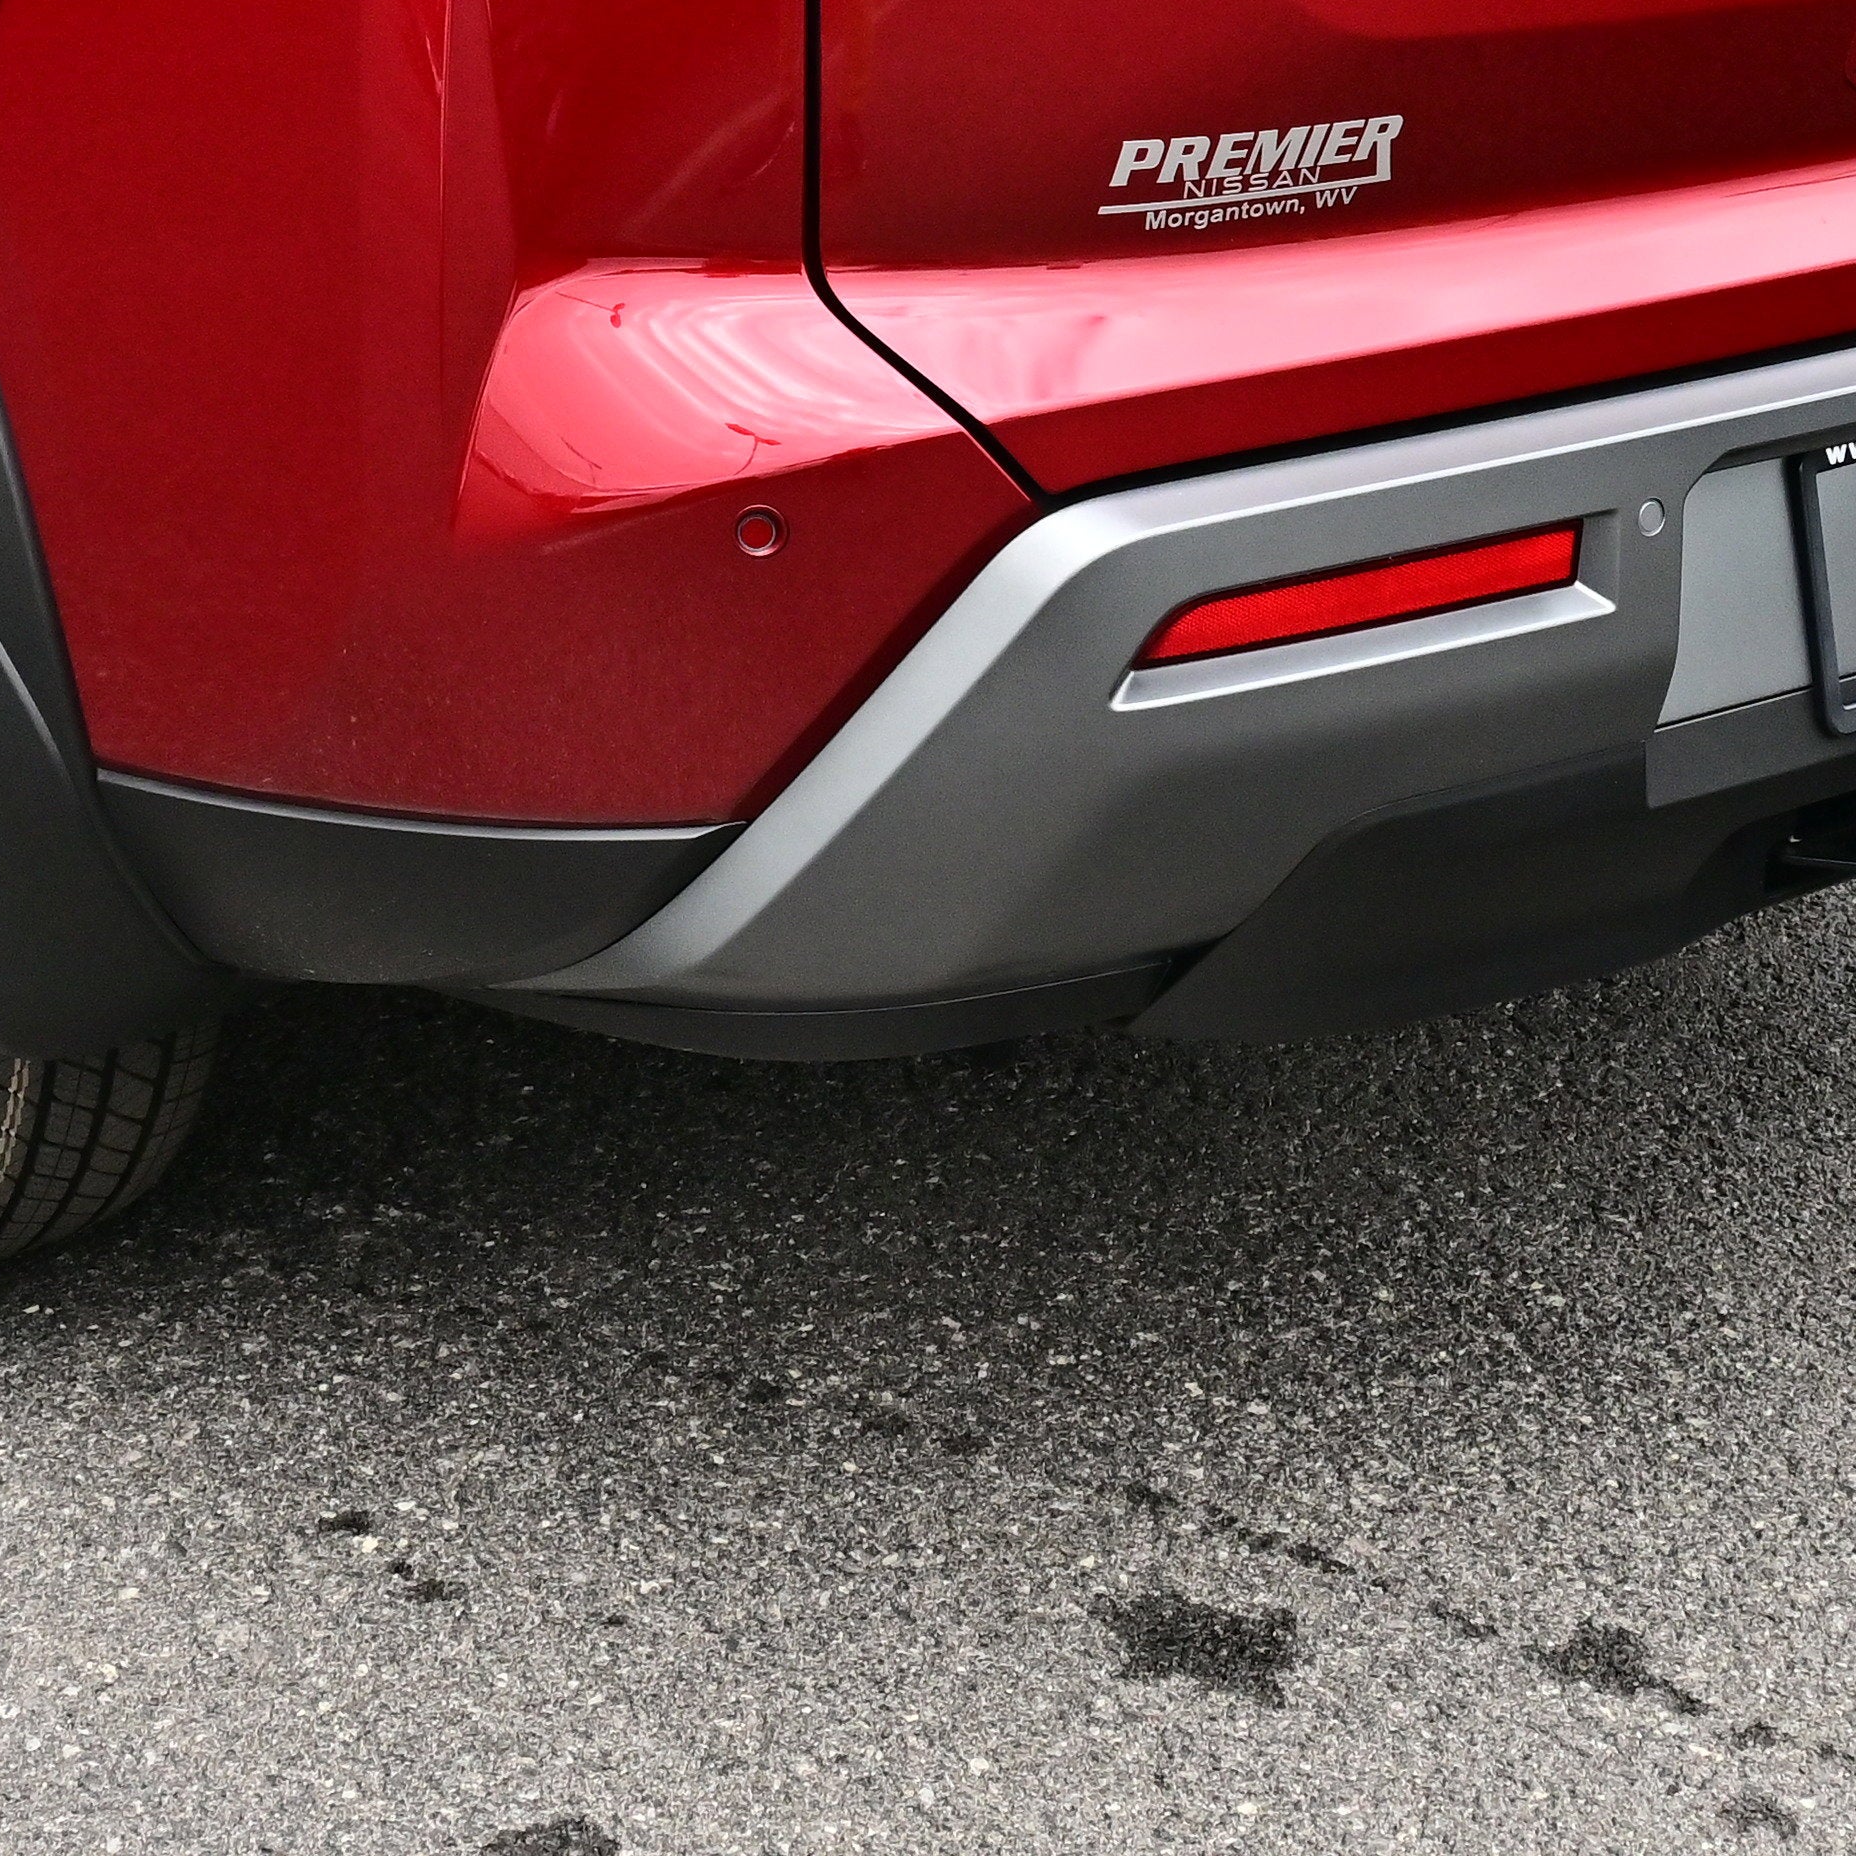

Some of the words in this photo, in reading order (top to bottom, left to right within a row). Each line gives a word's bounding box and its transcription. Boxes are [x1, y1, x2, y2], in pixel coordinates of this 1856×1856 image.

[1108, 114, 1405, 188] PREMIER
[1182, 166, 1322, 200] NISSAN
[1144, 194, 1307, 232] Morgantown,
[1315, 186, 1359, 210] WV
